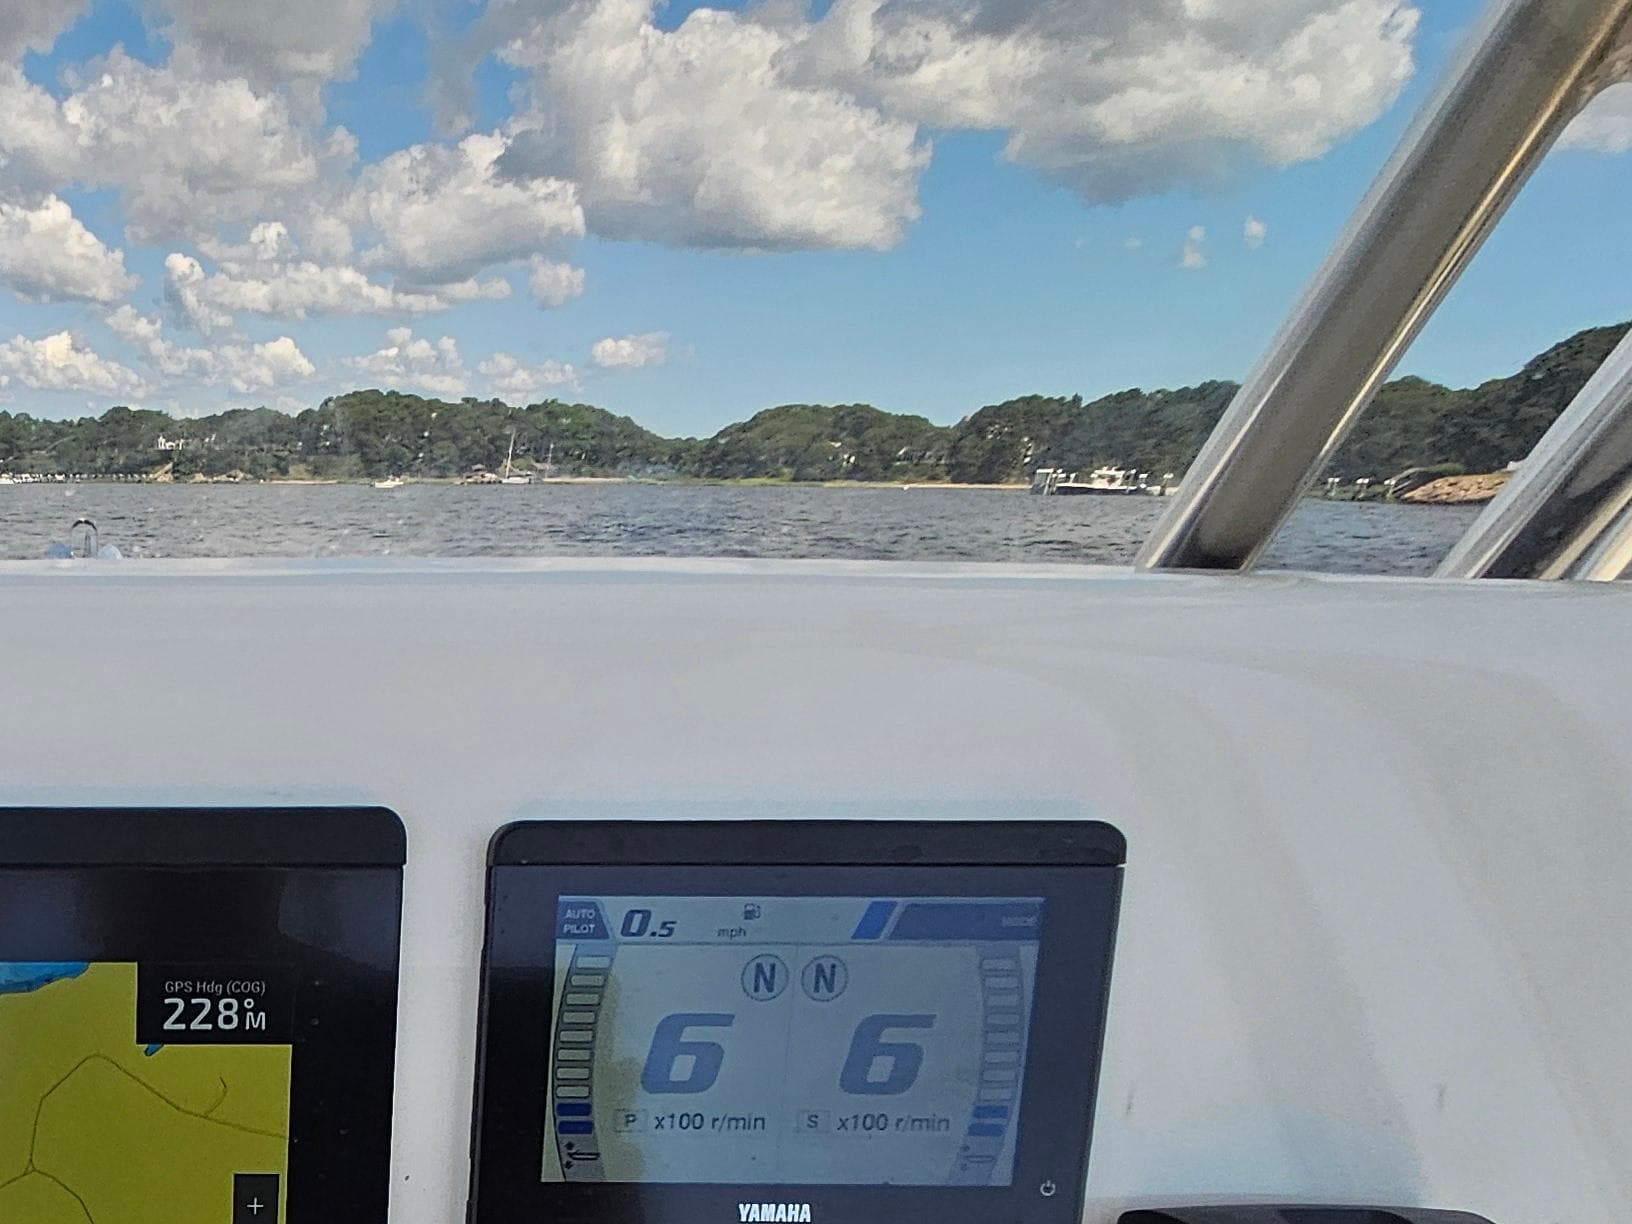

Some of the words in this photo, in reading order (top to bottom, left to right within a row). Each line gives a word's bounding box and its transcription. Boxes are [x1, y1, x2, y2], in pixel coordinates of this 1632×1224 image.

[564, 908, 595, 920] AUTO
[620, 909, 677, 938] 0.5
[563, 923, 595, 935] PILOT
[717, 927, 747, 939] mph
[164, 980, 193, 994] GPS
[196, 980, 223, 995] Hdg
[226, 980, 267, 995] (COG)
[753, 962, 776, 994] N
[814, 962, 838, 994] N
[640, 1012, 736, 1095] 6
[839, 1013, 937, 1096] 6
[654, 1112, 705, 1131] x100
[711, 1112, 766, 1132] r/min
[837, 1112, 889, 1132] x100
[895, 1113, 950, 1132] r/min
[738, 1203, 812, 1224] YAMAHA
